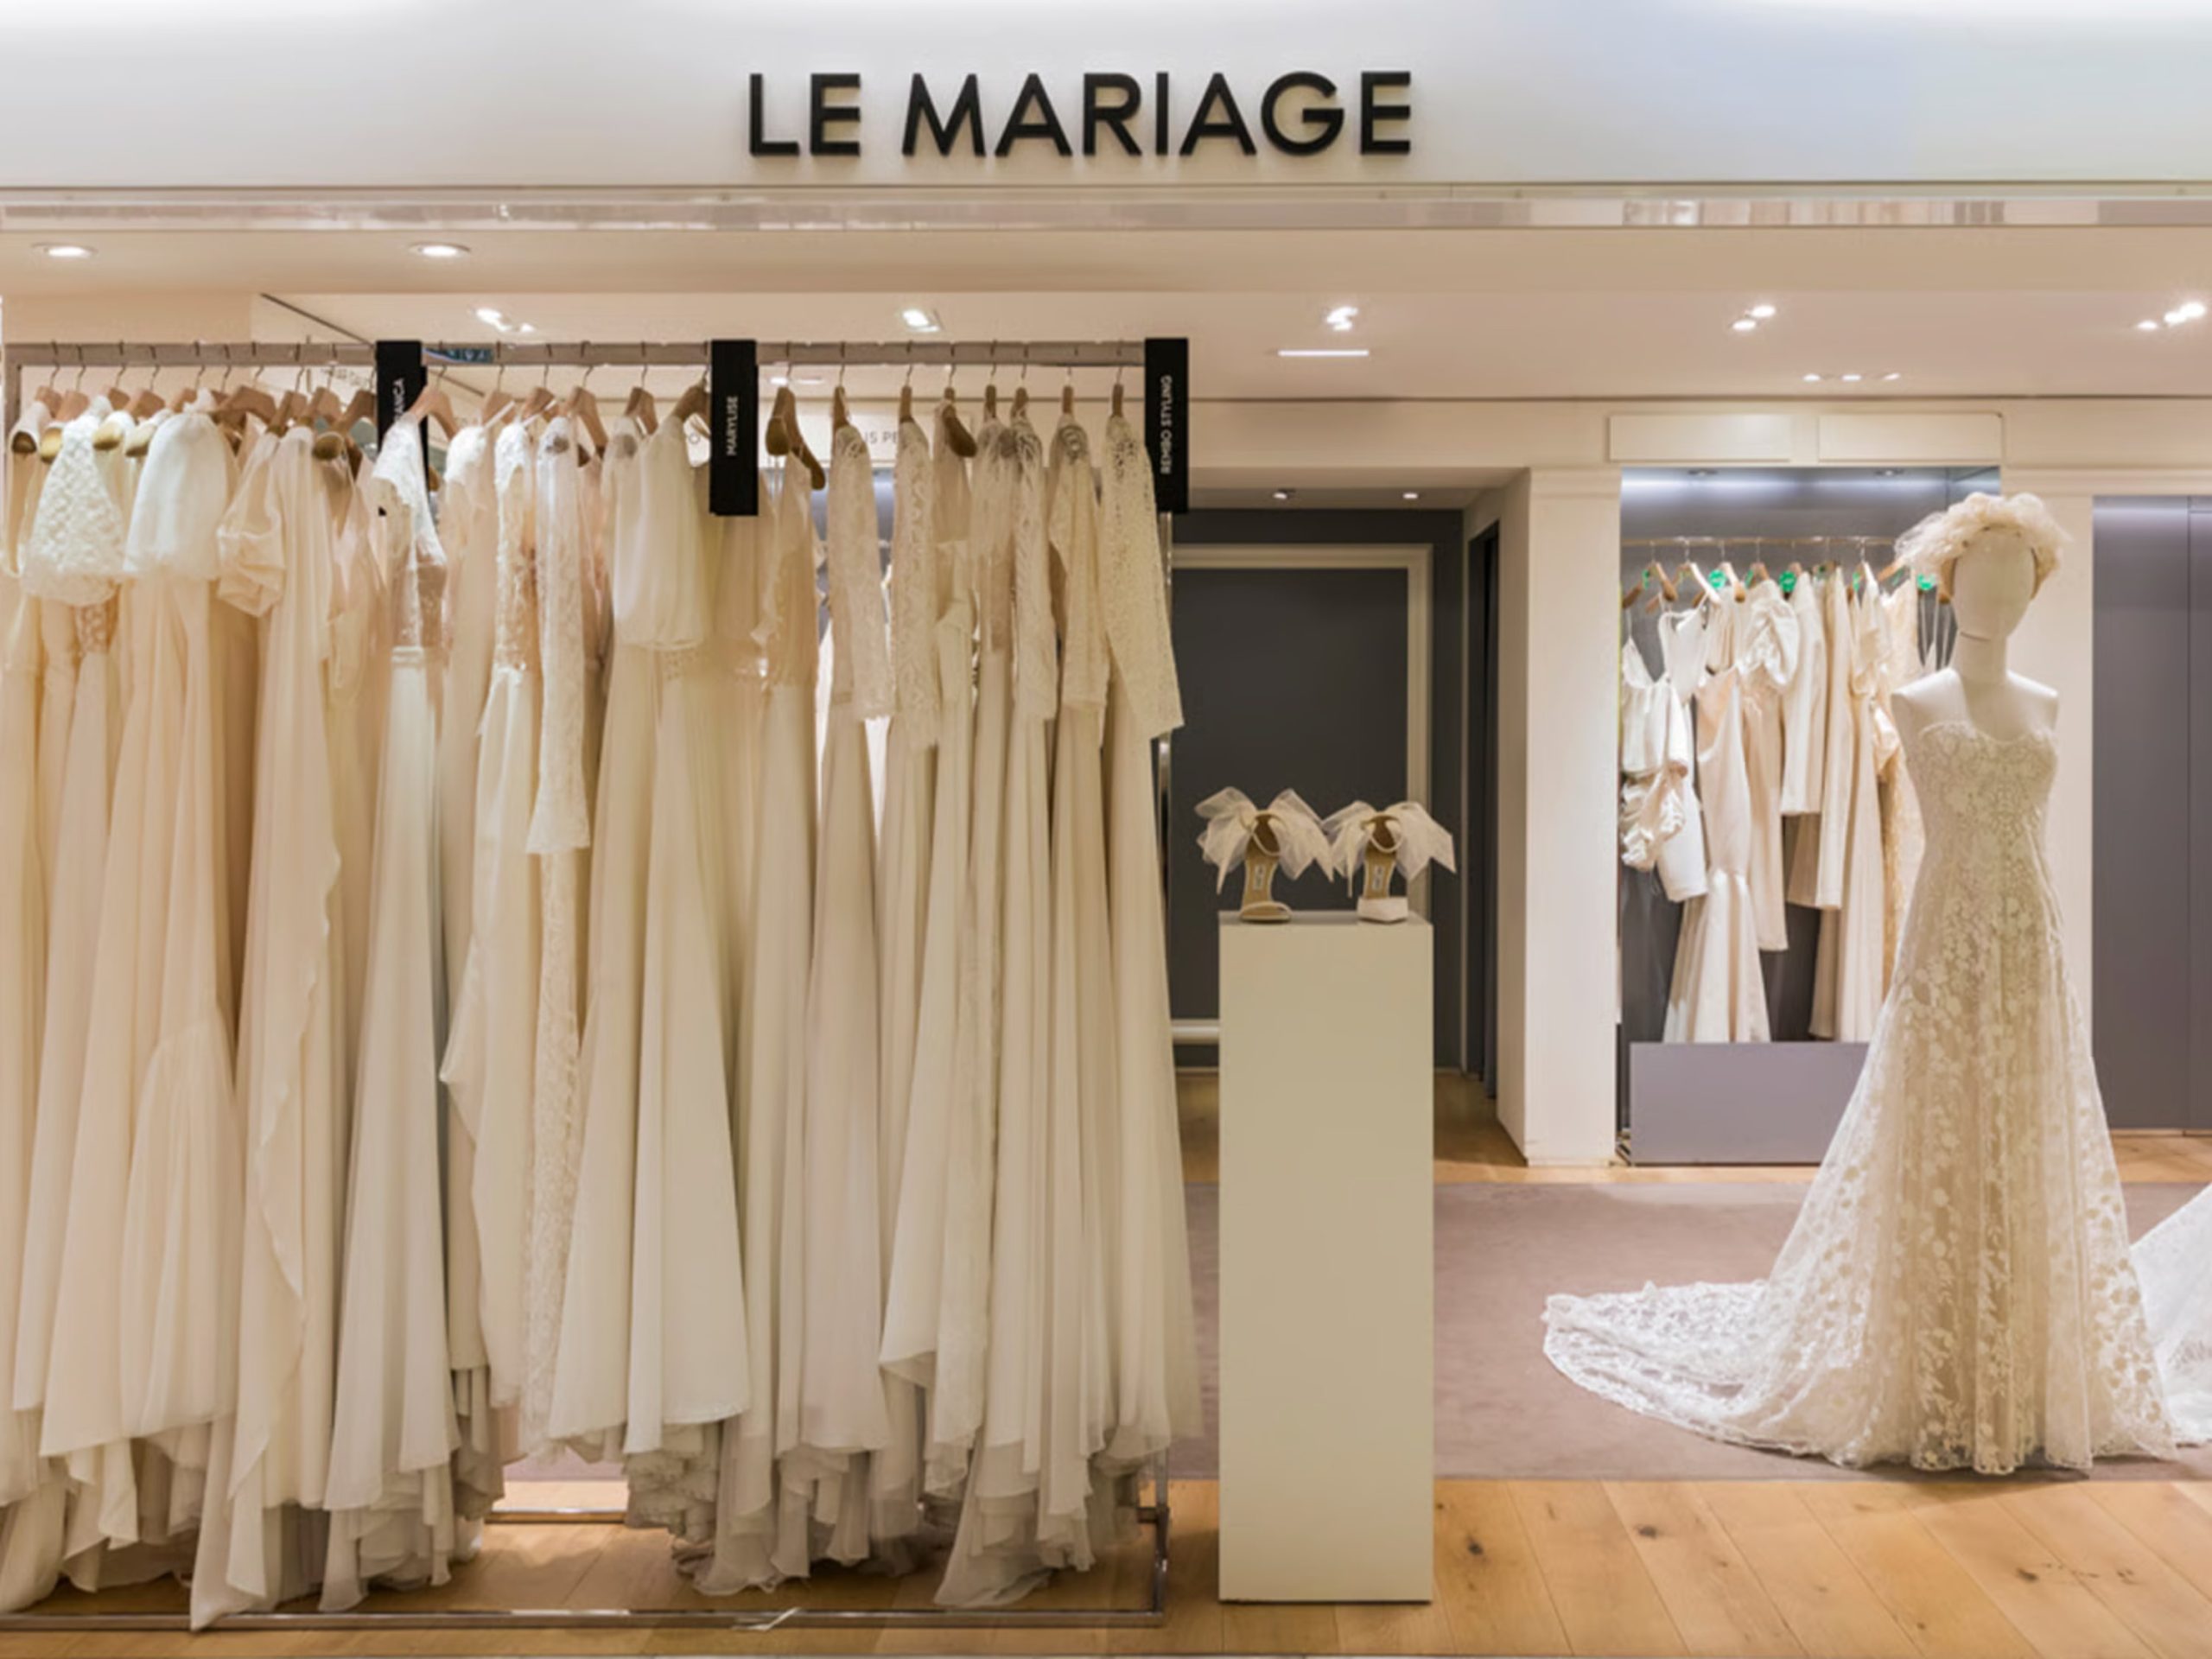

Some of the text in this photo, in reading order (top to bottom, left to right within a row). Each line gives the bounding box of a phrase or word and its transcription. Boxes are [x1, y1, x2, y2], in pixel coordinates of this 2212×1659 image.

[749, 72, 1412, 157] LE MARIAGE
[726, 396, 738, 456] MARYLISE
[1160, 374, 1173, 474] REMBO STYLING
